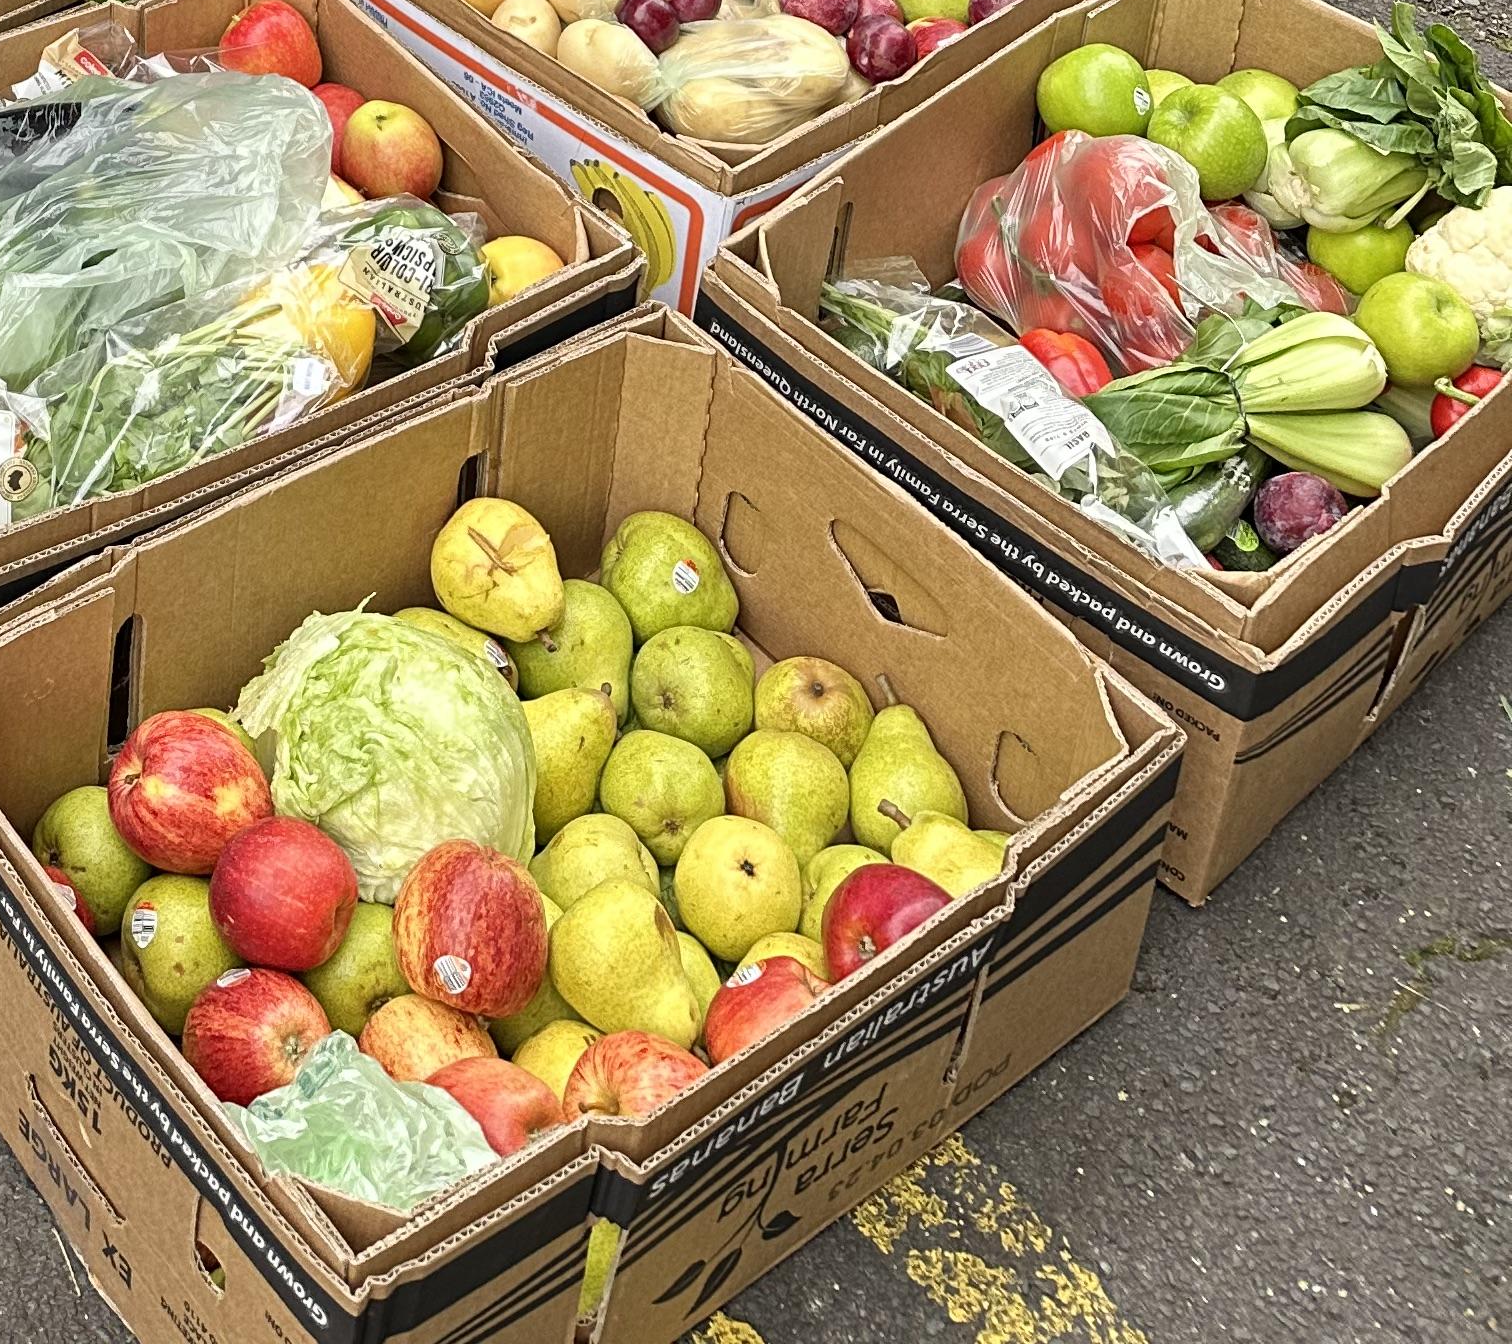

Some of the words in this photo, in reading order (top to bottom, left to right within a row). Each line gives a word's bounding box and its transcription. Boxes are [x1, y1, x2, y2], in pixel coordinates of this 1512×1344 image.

[361, 265, 428, 315] USTRALIAN
[709, 321, 792, 397] Queensland
[791, 391, 839, 432] North
[838, 424, 867, 452] Far
[867, 444, 888, 465] in
[884, 456, 941, 507] Family
[940, 499, 988, 540] Serra
[989, 529, 1021, 561] the
[1020, 548, 1045, 575] by
[1045, 568, 1115, 621] packed
[1114, 614, 1157, 648] and
[1157, 639, 1227, 693] Grown
[0, 896, 22, 931] Far
[22, 927, 39, 953] in
[34, 947, 82, 1017] Family
[822, 936, 995, 1071] Australian
[79, 1012, 122, 1065] Serra
[48, 1046, 103, 1137] 15KG
[119, 1060, 151, 1101] the
[950, 1053, 1013, 1107] POD
[148, 1097, 171, 1130] by
[648, 1072, 806, 1200] Bananas
[17, 1105, 92, 1233] LARGE
[169, 1129, 232, 1209] packed
[794, 1107, 900, 1196] Serra
[229, 1205, 266, 1250] and
[101, 1229, 133, 1292] EX
[264, 1247, 330, 1328] Grown
